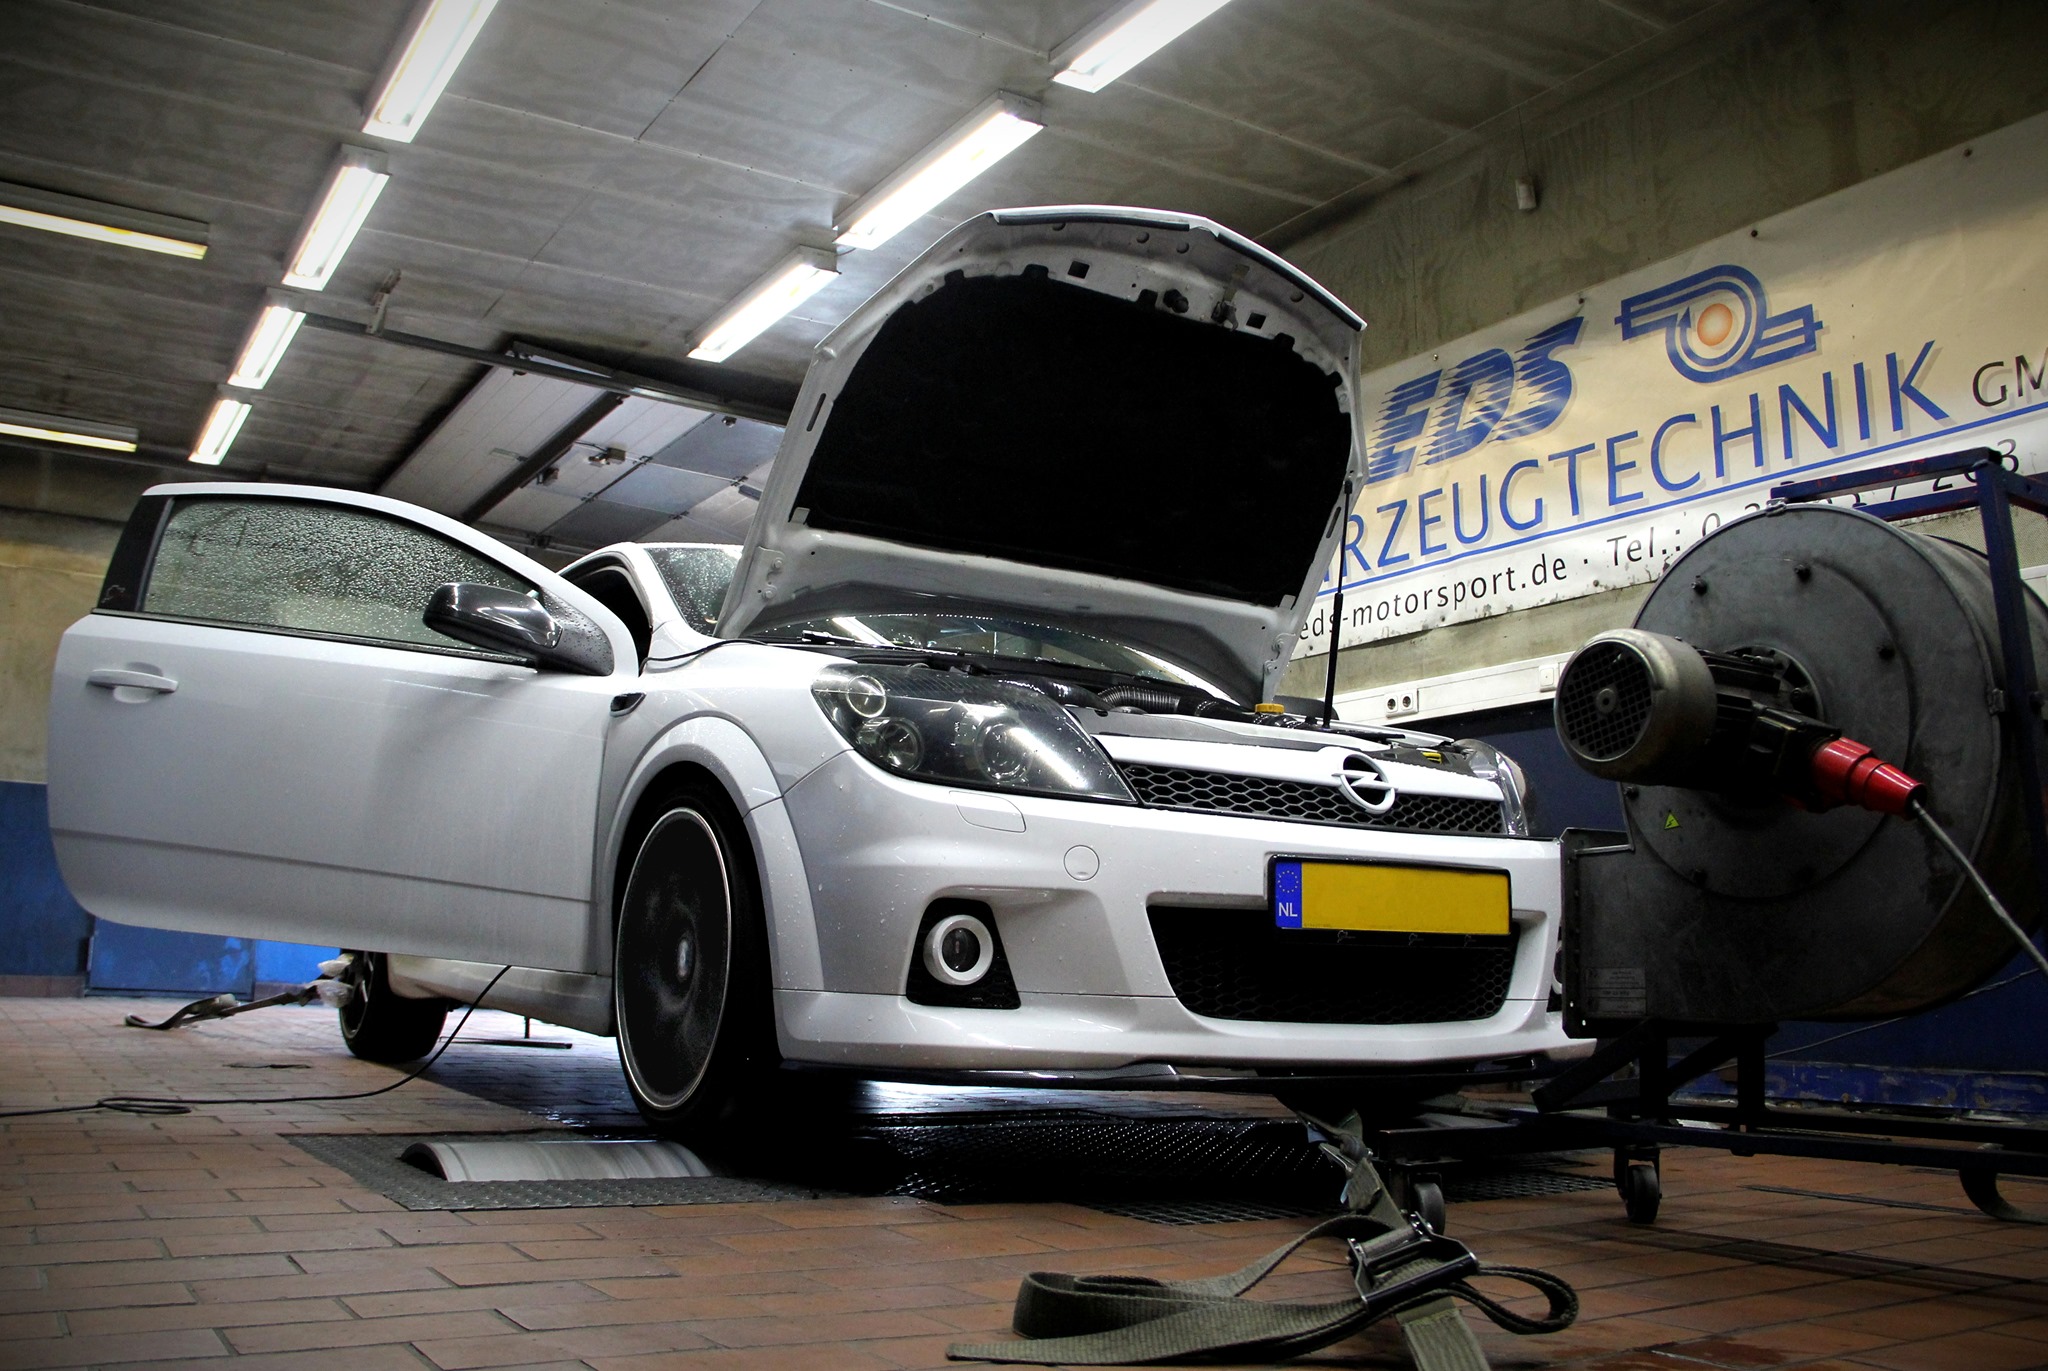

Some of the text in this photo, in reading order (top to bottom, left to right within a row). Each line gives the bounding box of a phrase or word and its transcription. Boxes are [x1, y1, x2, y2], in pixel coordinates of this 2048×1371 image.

[1322, 339, 1950, 583] RZEUGTECHNIK
[1365, 316, 1585, 485] EDS
[1278, 902, 1298, 917] NL
